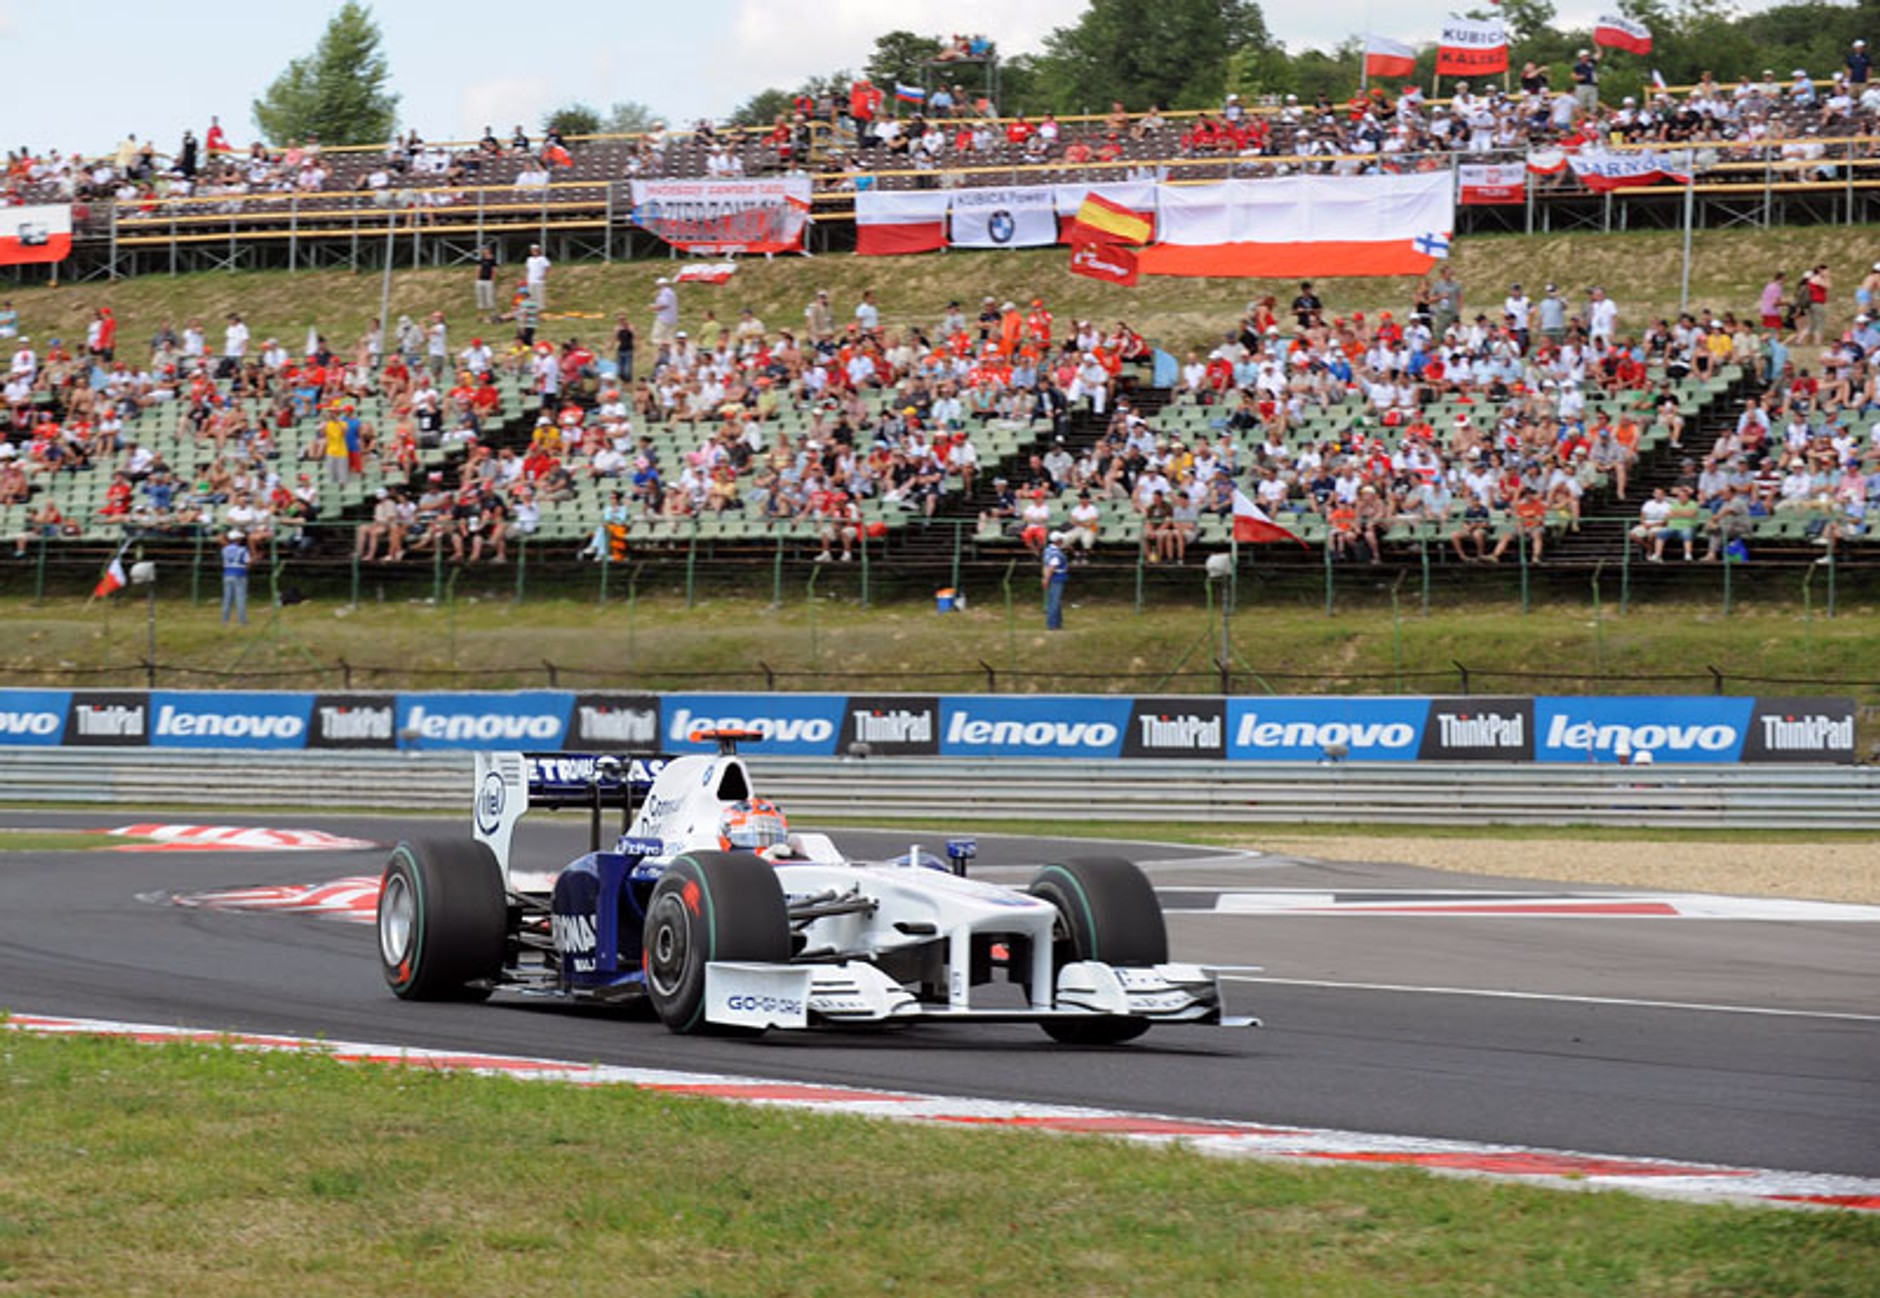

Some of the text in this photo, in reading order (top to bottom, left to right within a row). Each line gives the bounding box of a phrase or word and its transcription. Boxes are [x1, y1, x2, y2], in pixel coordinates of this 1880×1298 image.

[0, 712, 59, 735] vo
[156, 705, 303, 737] lenovo
[320, 707, 391, 738] ThinkPad
[407, 706, 560, 739] lenovo
[854, 710, 931, 742] ThinkPad
[947, 712, 1117, 746] lenovo
[1140, 714, 1220, 748] ThinkPad
[1237, 713, 1414, 748] lenovo
[1437, 713, 1523, 747] ThinkPad
[1546, 714, 1736, 750] lenovo
[1761, 715, 1853, 750] ThinkPad
